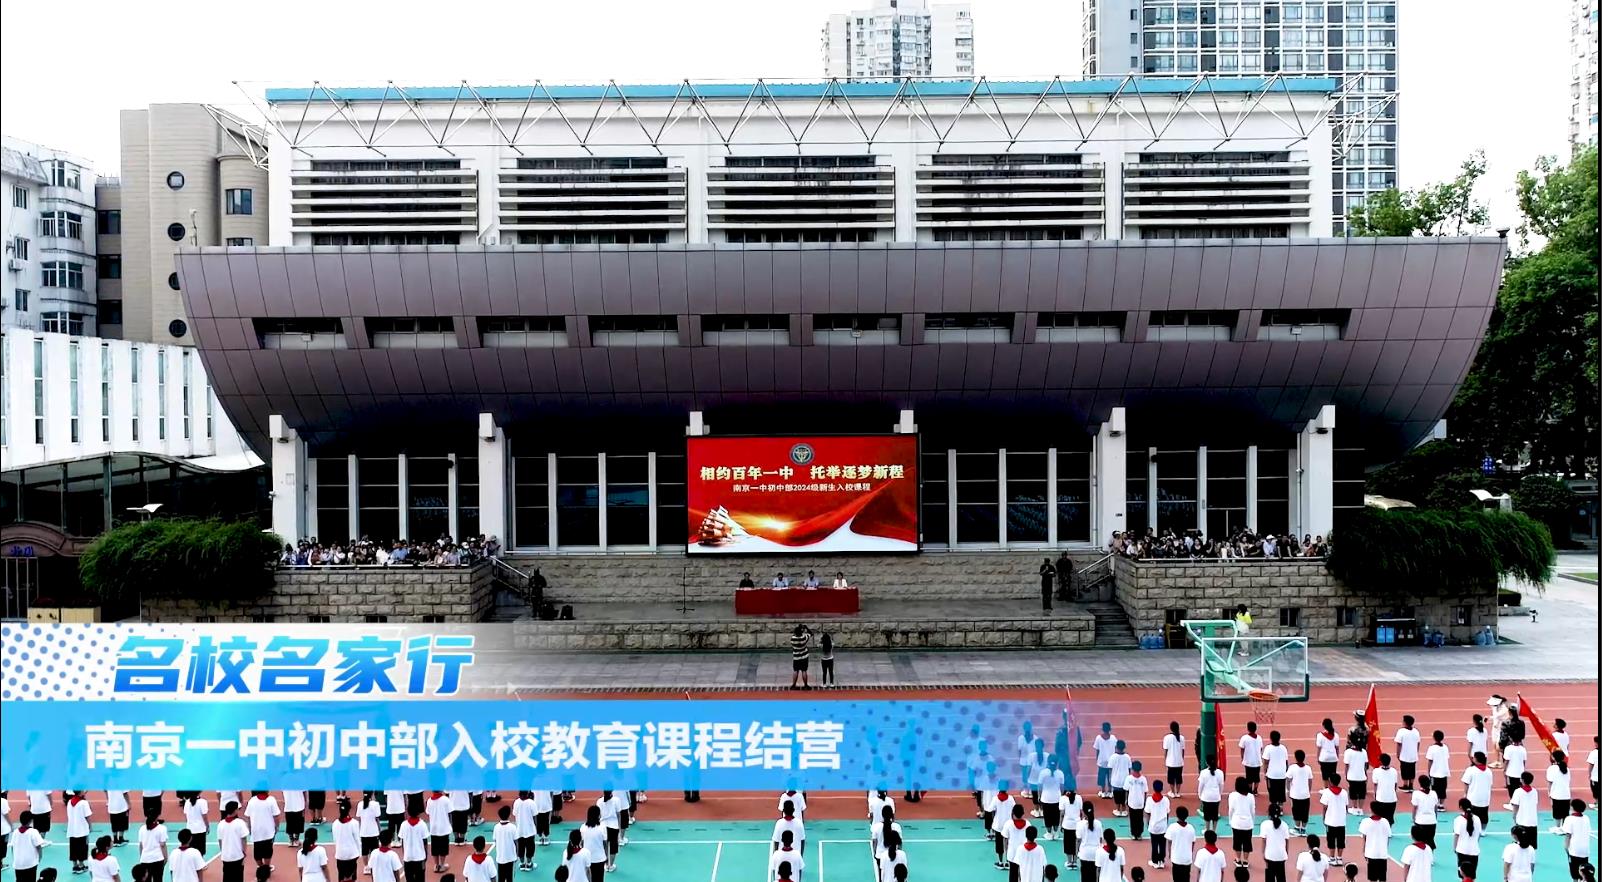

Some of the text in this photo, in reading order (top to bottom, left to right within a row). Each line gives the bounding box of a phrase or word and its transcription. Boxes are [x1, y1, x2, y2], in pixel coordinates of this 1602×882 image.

[700, 464, 904, 481] 相约百年一中 托举逐梦新程
